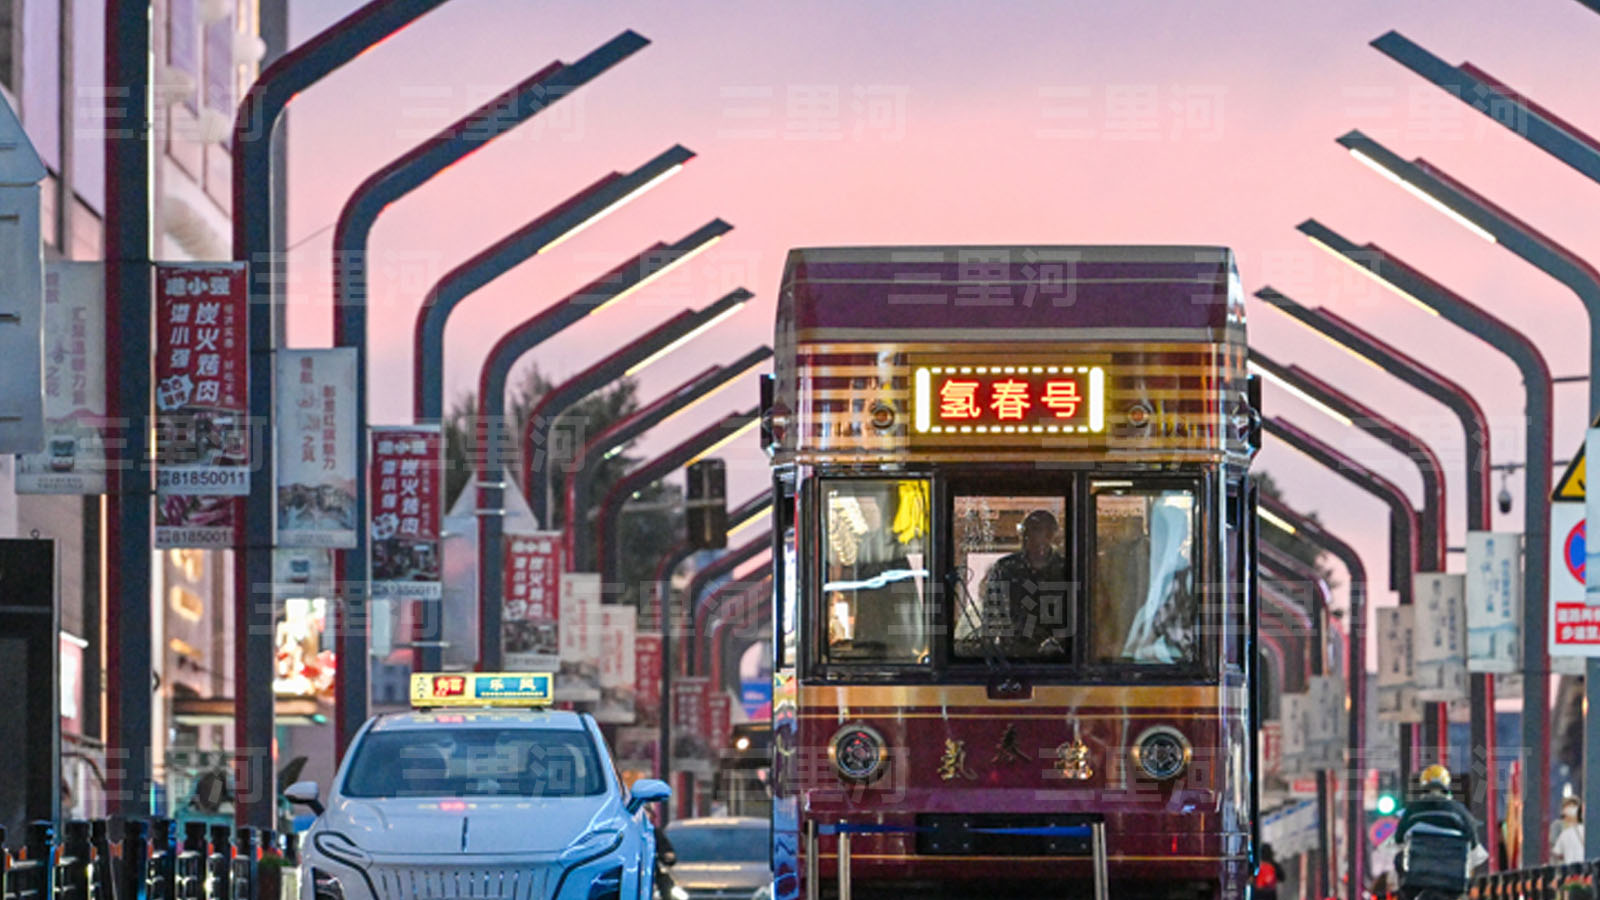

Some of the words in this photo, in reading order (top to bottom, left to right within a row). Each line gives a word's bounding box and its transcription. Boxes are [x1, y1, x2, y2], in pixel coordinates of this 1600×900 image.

[940, 380, 1081, 419] 氢春号
[172, 472, 245, 486] 81850011
